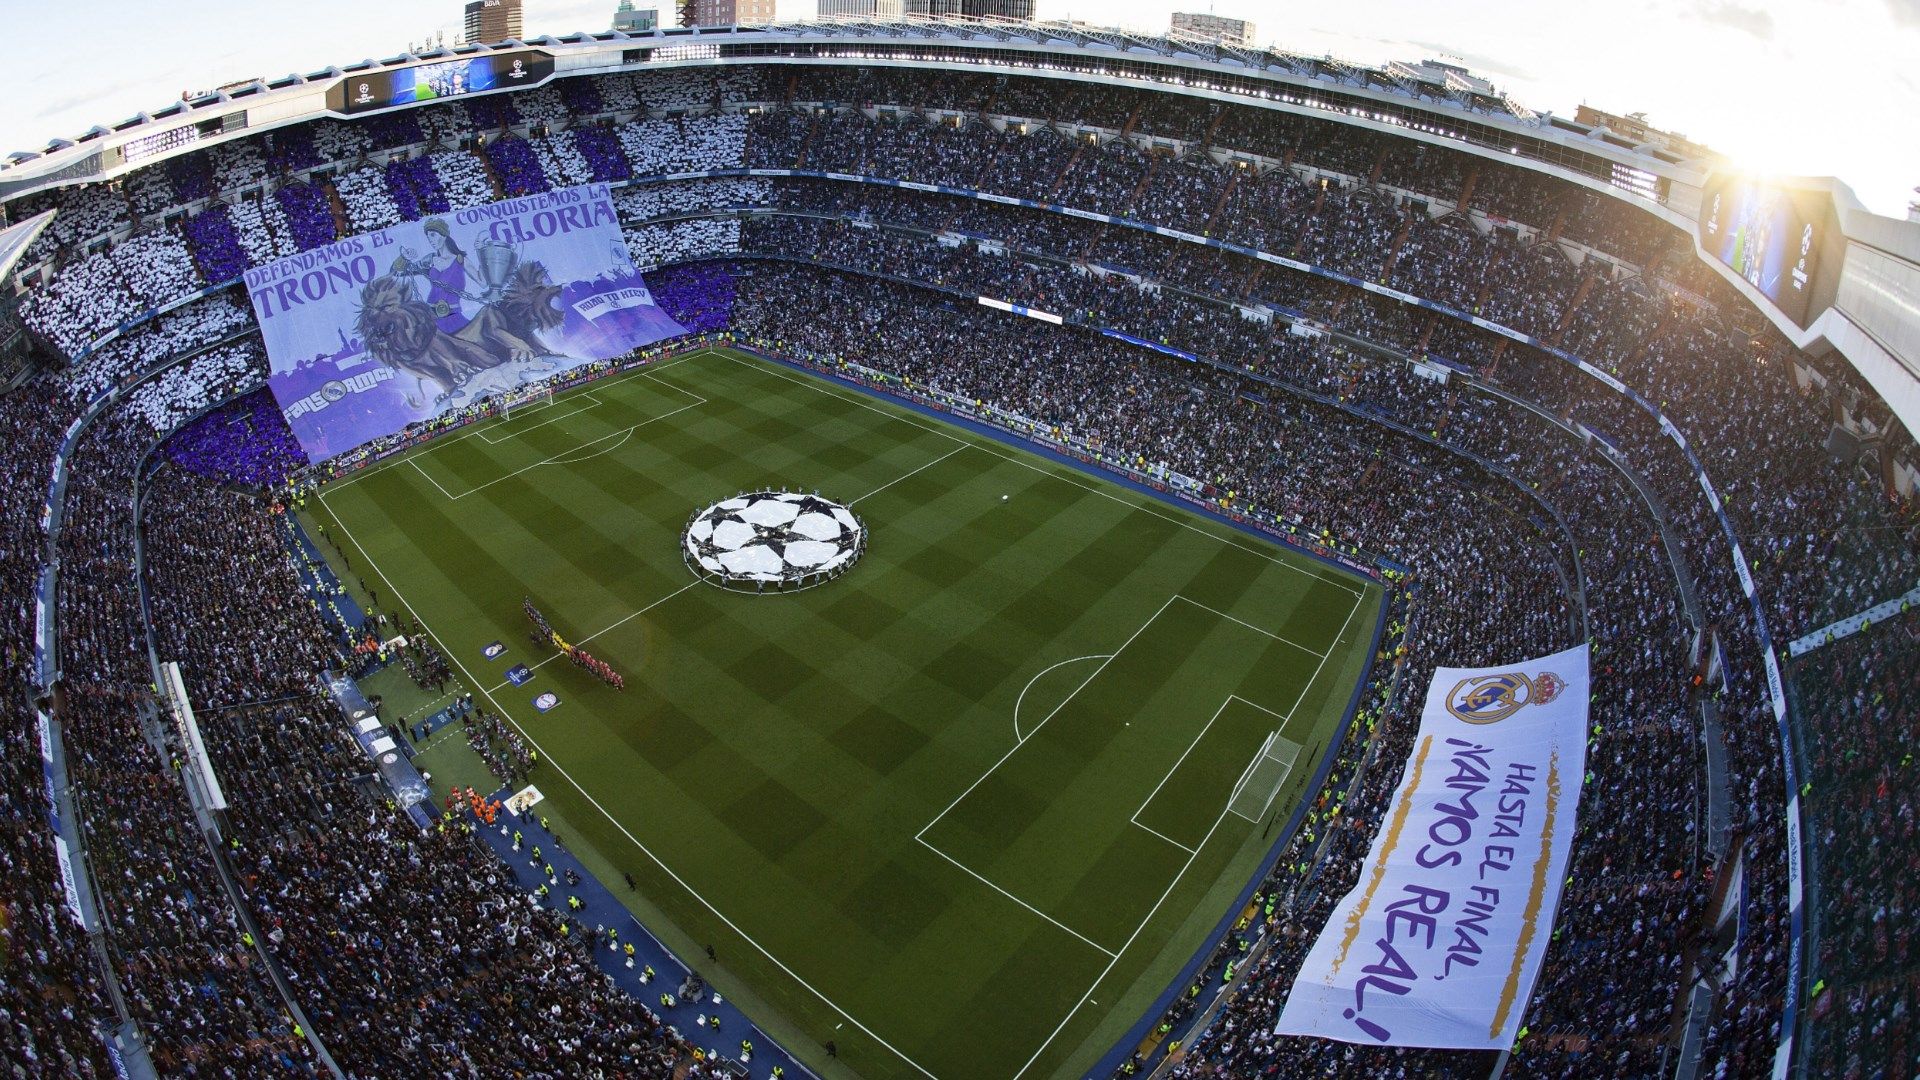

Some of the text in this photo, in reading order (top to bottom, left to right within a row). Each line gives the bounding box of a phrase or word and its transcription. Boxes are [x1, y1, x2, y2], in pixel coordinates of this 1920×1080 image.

[456, 184, 610, 226] CONQUISTEMOS LA
[489, 200, 617, 244] GLORIA
[246, 230, 394, 288] DEFENDAMOS EL
[252, 255, 376, 319] TRONO
[1263, 526, 1286, 538] RESPECT
[1488, 763, 1536, 838] HASTA
[61, 858, 80, 910] Real Madrid
[1480, 845, 1514, 880] EL
[1342, 737, 1494, 1042] ¡VAMOS REAL!
